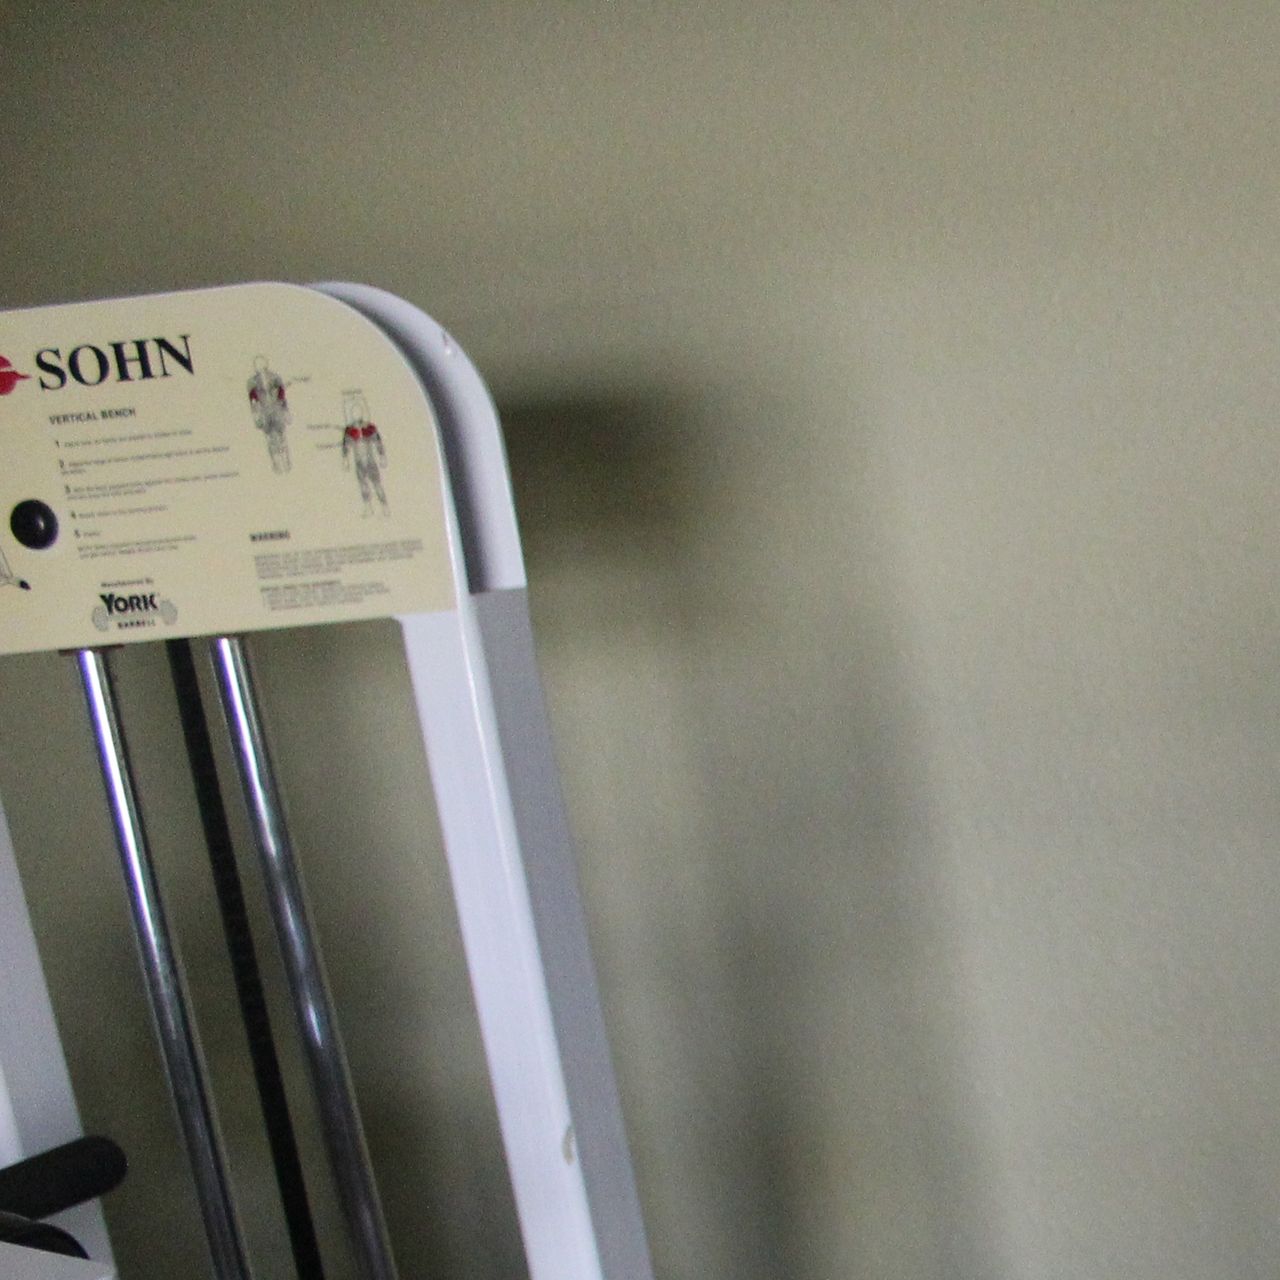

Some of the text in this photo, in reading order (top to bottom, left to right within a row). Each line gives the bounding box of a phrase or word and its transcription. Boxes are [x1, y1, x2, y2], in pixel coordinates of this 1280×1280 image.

[35, 334, 195, 391] SOHN
[49, 408, 136, 425] VERTICAL BENCH
[99, 592, 158, 615] YORK
